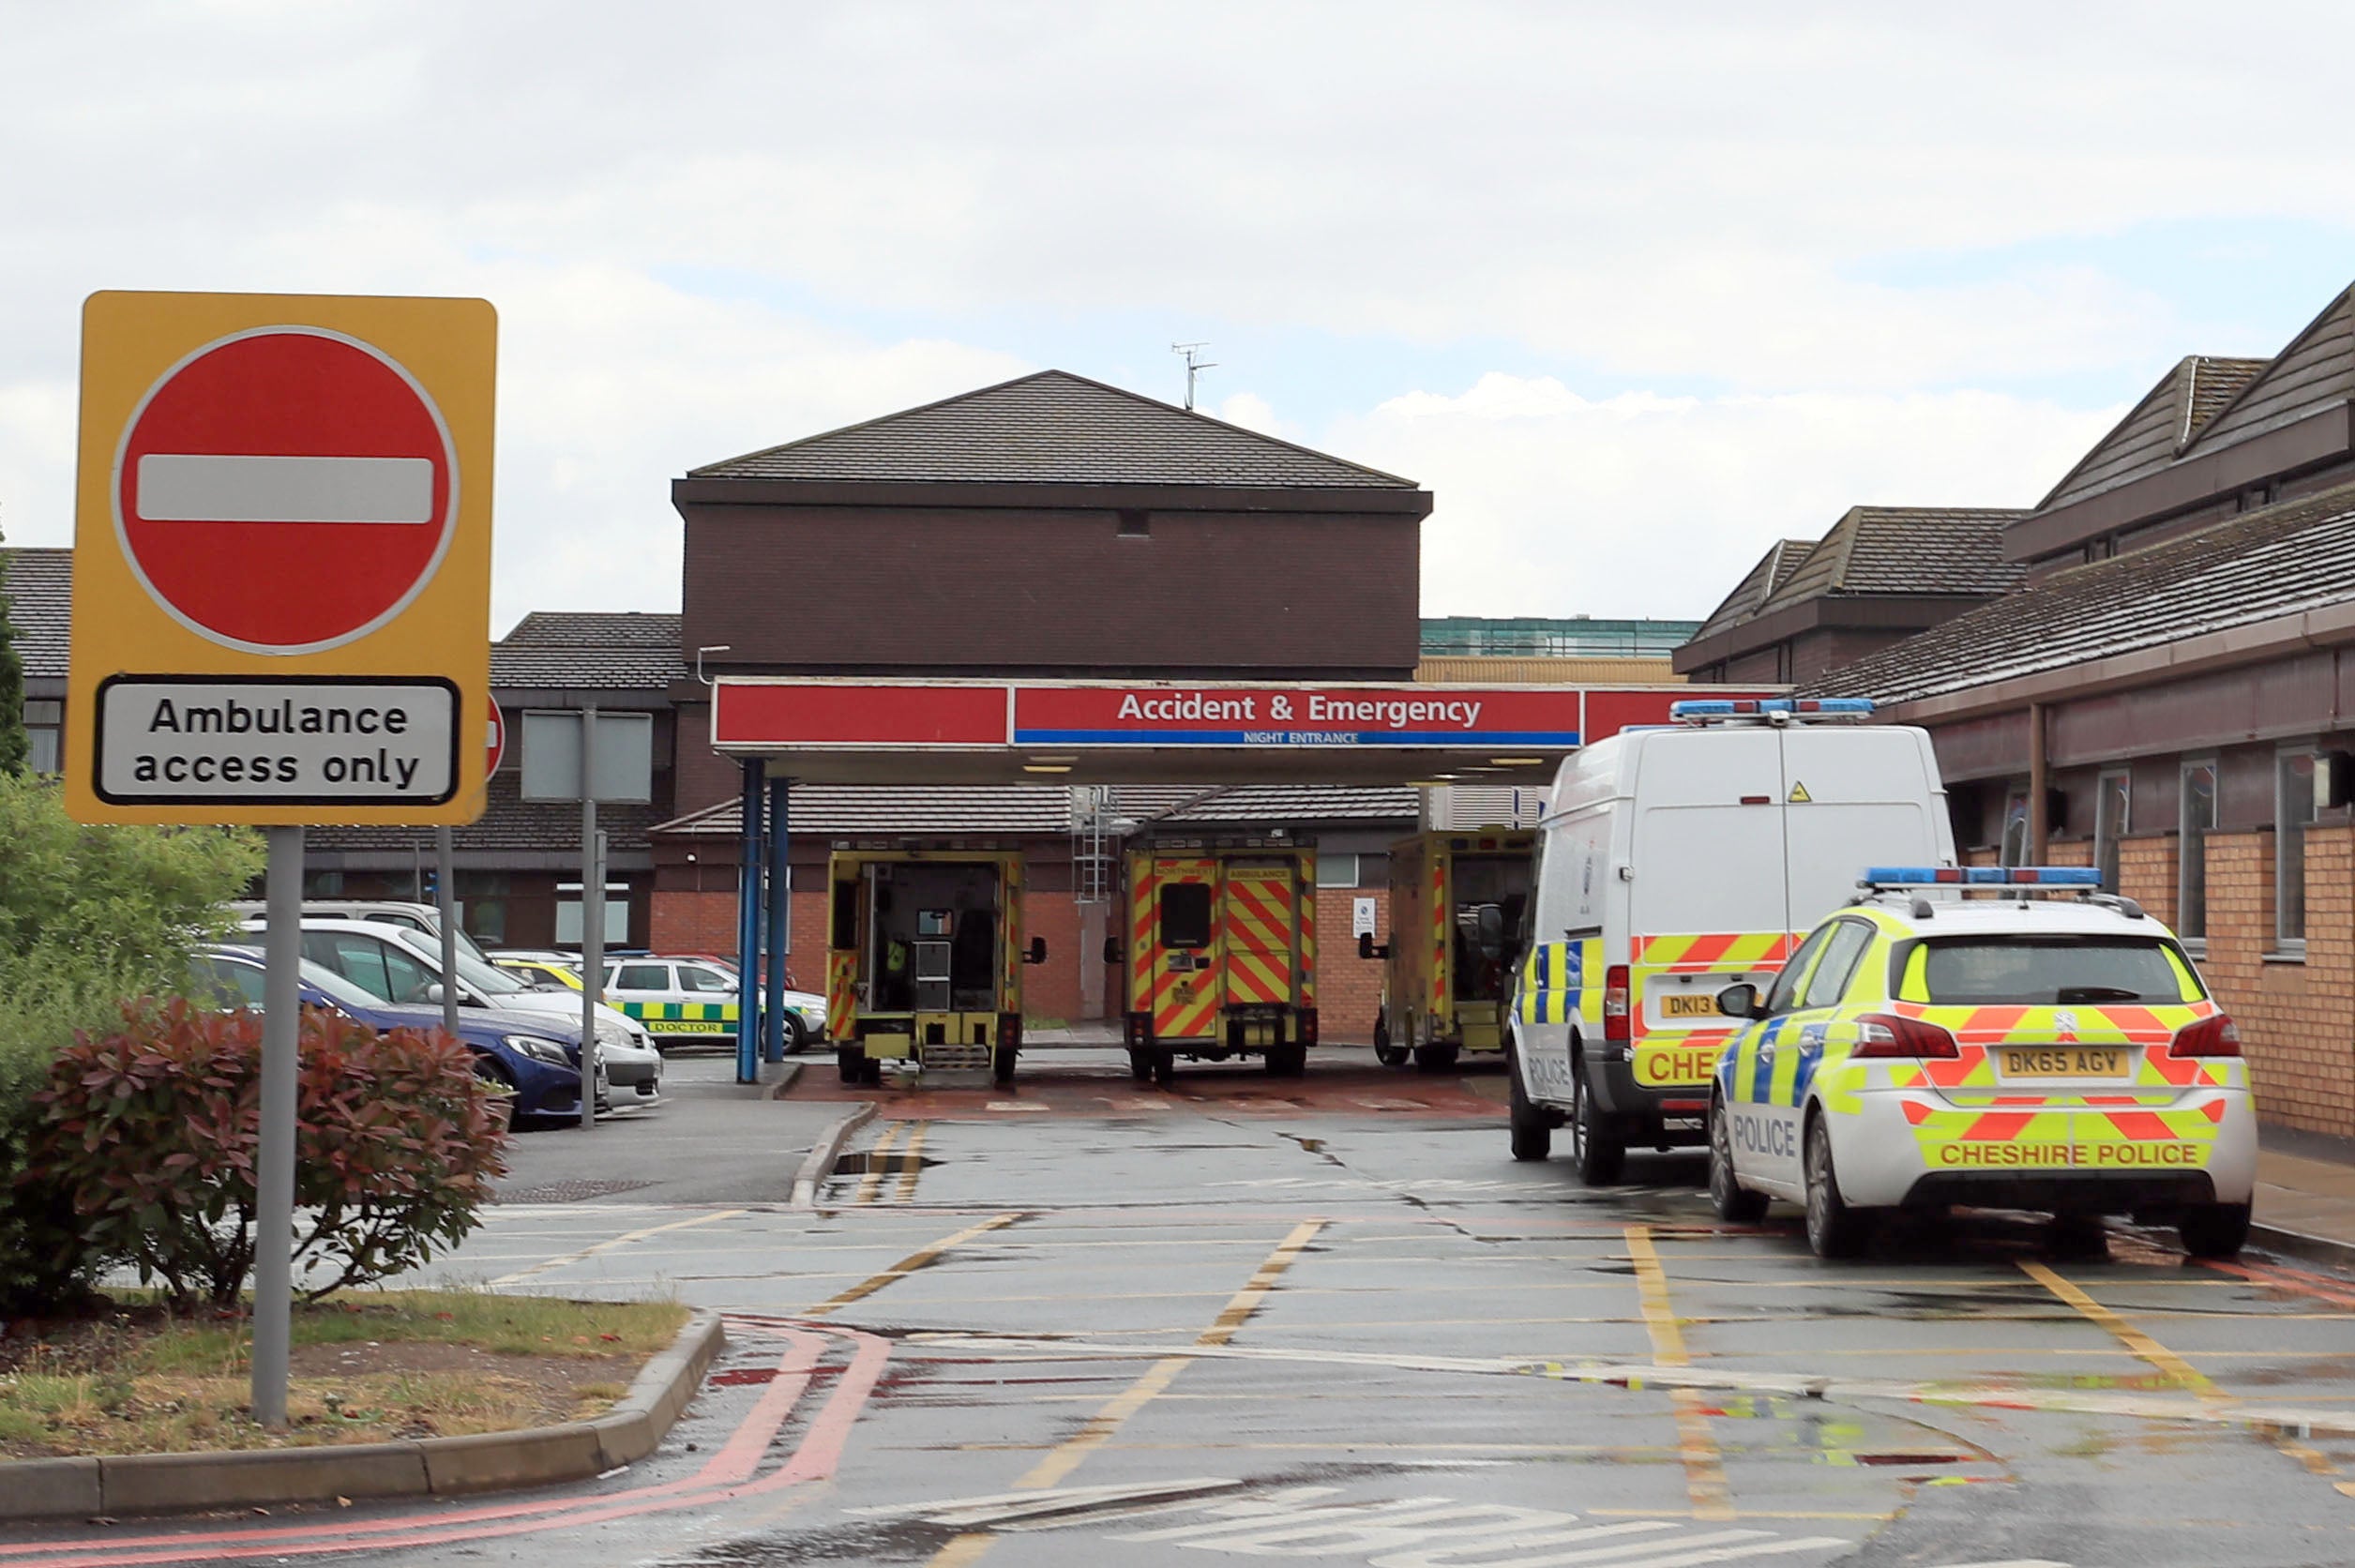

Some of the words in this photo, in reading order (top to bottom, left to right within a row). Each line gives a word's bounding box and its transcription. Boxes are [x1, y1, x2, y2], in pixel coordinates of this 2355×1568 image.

[148, 698, 409, 734] Ambulance
[1118, 693, 1256, 721] Accident
[1270, 695, 1293, 721] &
[1308, 695, 1481, 728] Emergency
[1244, 732, 1284, 744] NIGHT
[1289, 732, 1359, 744] ENTRANCE
[134, 754, 298, 783] access
[323, 748, 420, 790] only
[1230, 869, 1289, 879] AMBULANCE
[655, 1023, 718, 1032] DOCTOR
[1528, 1057, 1570, 1086] POLICE
[2008, 1052, 2068, 1073] DK65
[2076, 1050, 2117, 1071] AGV
[1734, 1115, 1796, 1157] POLICE
[1940, 1144, 2088, 1165] CHESHIRE
[2097, 1145, 2197, 1164] POLICE
